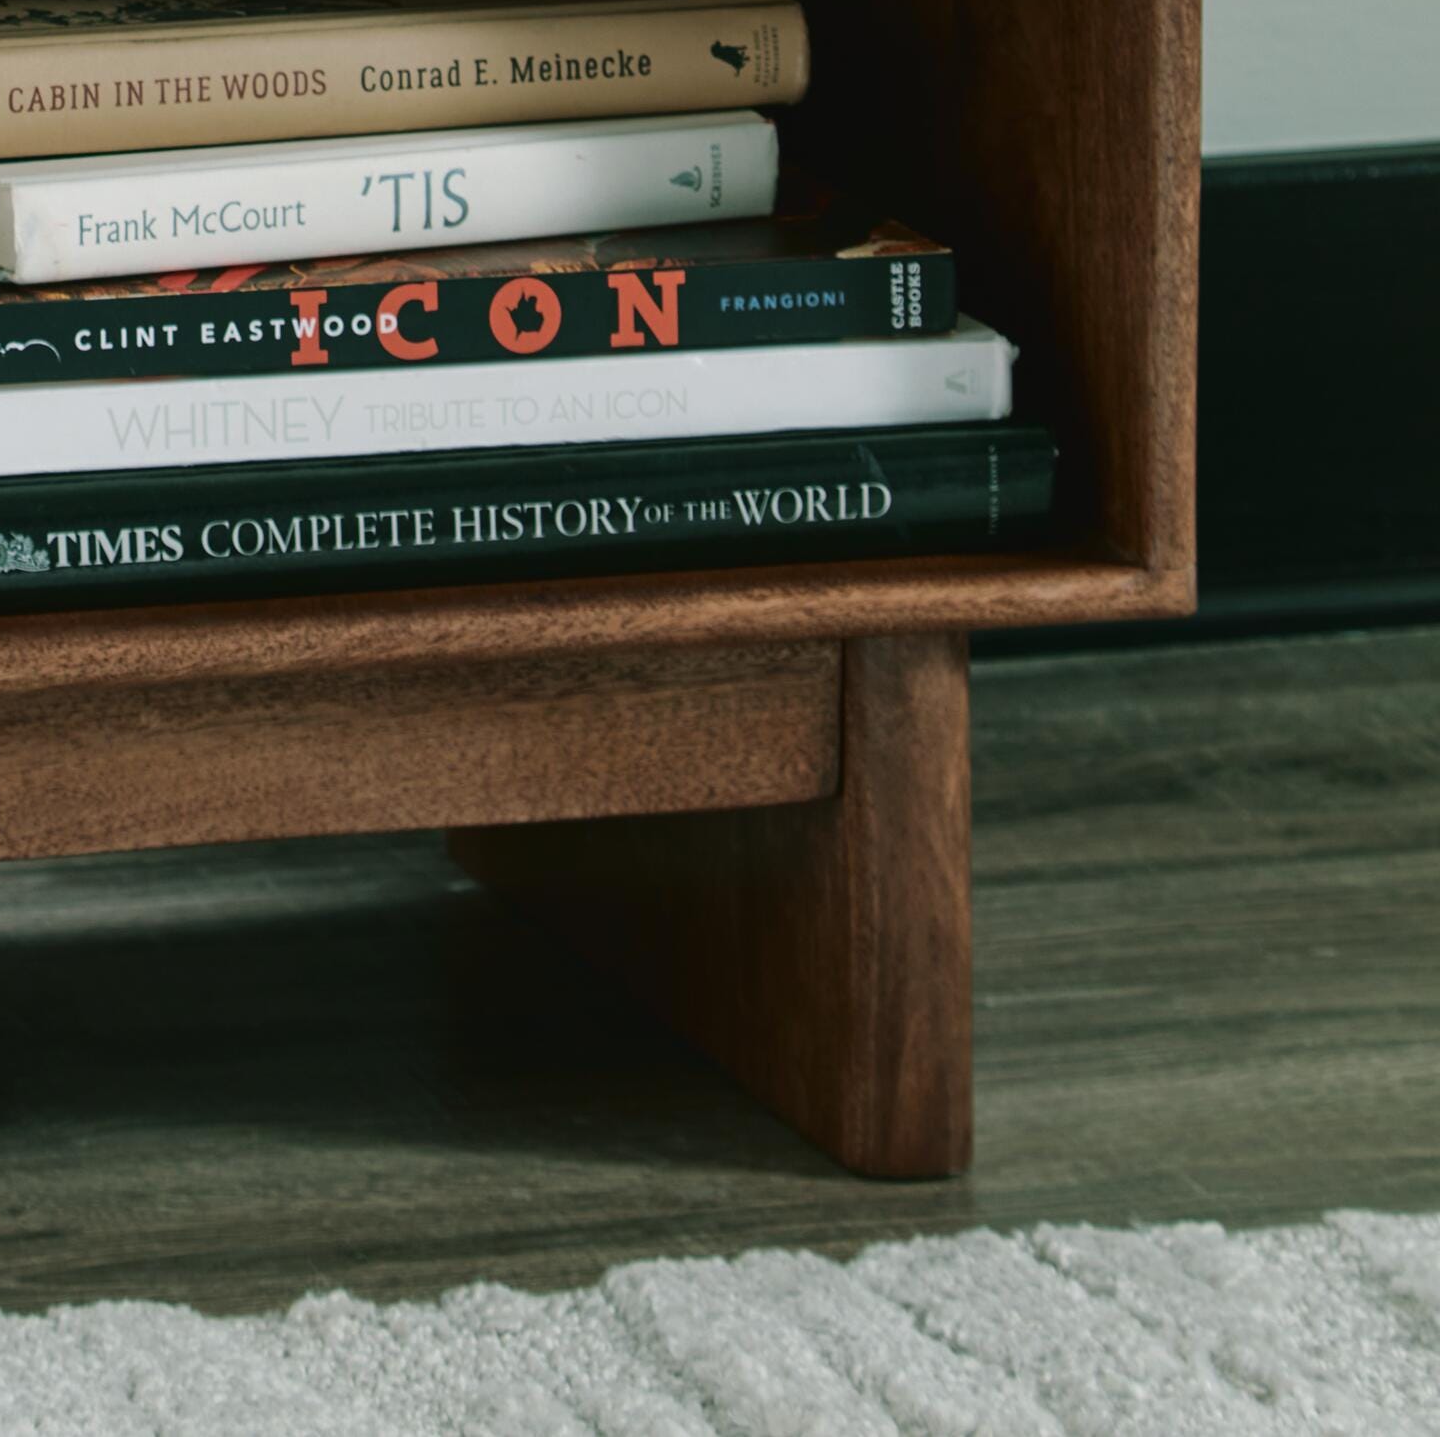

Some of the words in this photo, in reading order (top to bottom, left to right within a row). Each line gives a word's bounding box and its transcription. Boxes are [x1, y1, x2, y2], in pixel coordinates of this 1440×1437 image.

[8, 82, 101, 113] CABIN
[114, 79, 145, 108] IN
[155, 76, 212, 106] THE
[221, 69, 328, 101] WOODS
[360, 59, 461, 93] Conrad
[474, 58, 498, 87] E.
[510, 50, 652, 84] Meinecke
[78, 210, 157, 247] Frank
[171, 200, 306, 238] McCourt
[720, 291, 846, 313] FRANGIONI
[890, 261, 904, 330] CASTLE
[908, 261, 922, 328] BOOKS
[74, 325, 179, 352] CLINT
[201, 313, 399, 344] EASTWOOD
[106, 395, 344, 451] WHITNEY
[364, 398, 486, 433] TRIBUTE
[496, 396, 540, 426] TO
[548, 393, 593, 422] AN
[605, 387, 688, 420] ICON
[47, 525, 185, 568] TIMES
[200, 508, 437, 558] COMPLETE
[451, 495, 643, 544] HISTORY
[643, 502, 675, 524] OF
[683, 499, 732, 522] THE
[732, 481, 893, 526] WORLD
